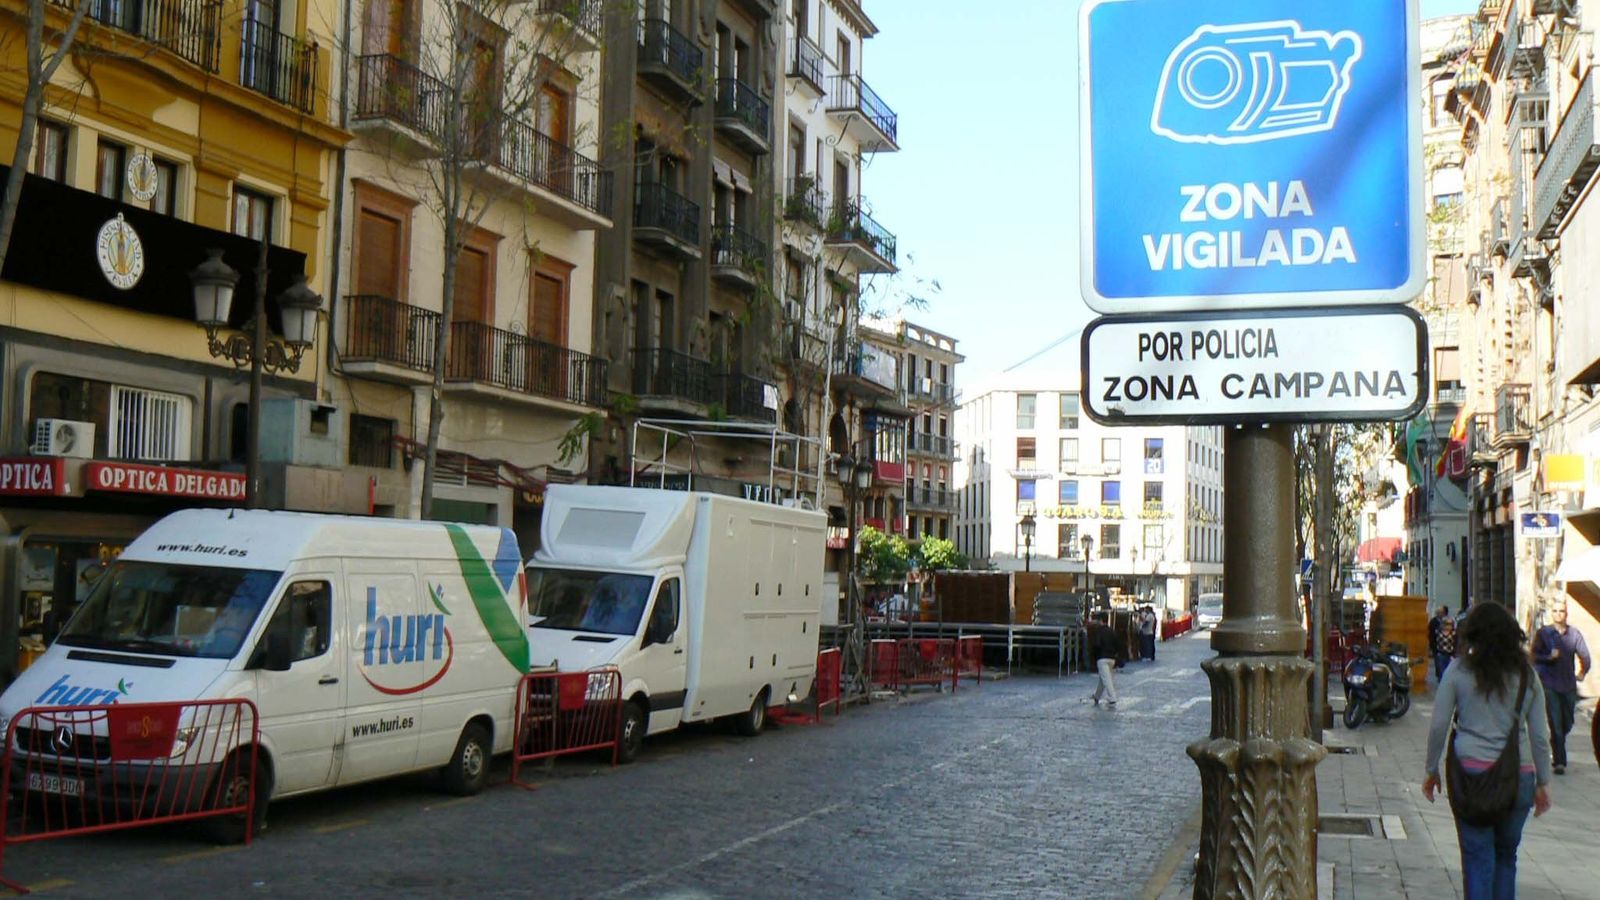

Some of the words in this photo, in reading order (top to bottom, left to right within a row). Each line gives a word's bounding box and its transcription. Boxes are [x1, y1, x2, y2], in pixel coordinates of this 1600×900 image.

[1179, 180, 1313, 222] ZONA
[1142, 226, 1357, 271] VIGILADA
[1138, 330, 1183, 362] POR
[1191, 327, 1279, 361] POLICIA
[1103, 374, 1200, 402] ZONA
[1220, 369, 1407, 401] CAMPANA
[0, 463, 53, 490] PTICA
[99, 466, 168, 491] OPTICA
[157, 543, 248, 557] www.huri.es
[363, 586, 444, 666] huri
[35, 674, 120, 706] huri
[352, 715, 414, 738] www.huri.es
